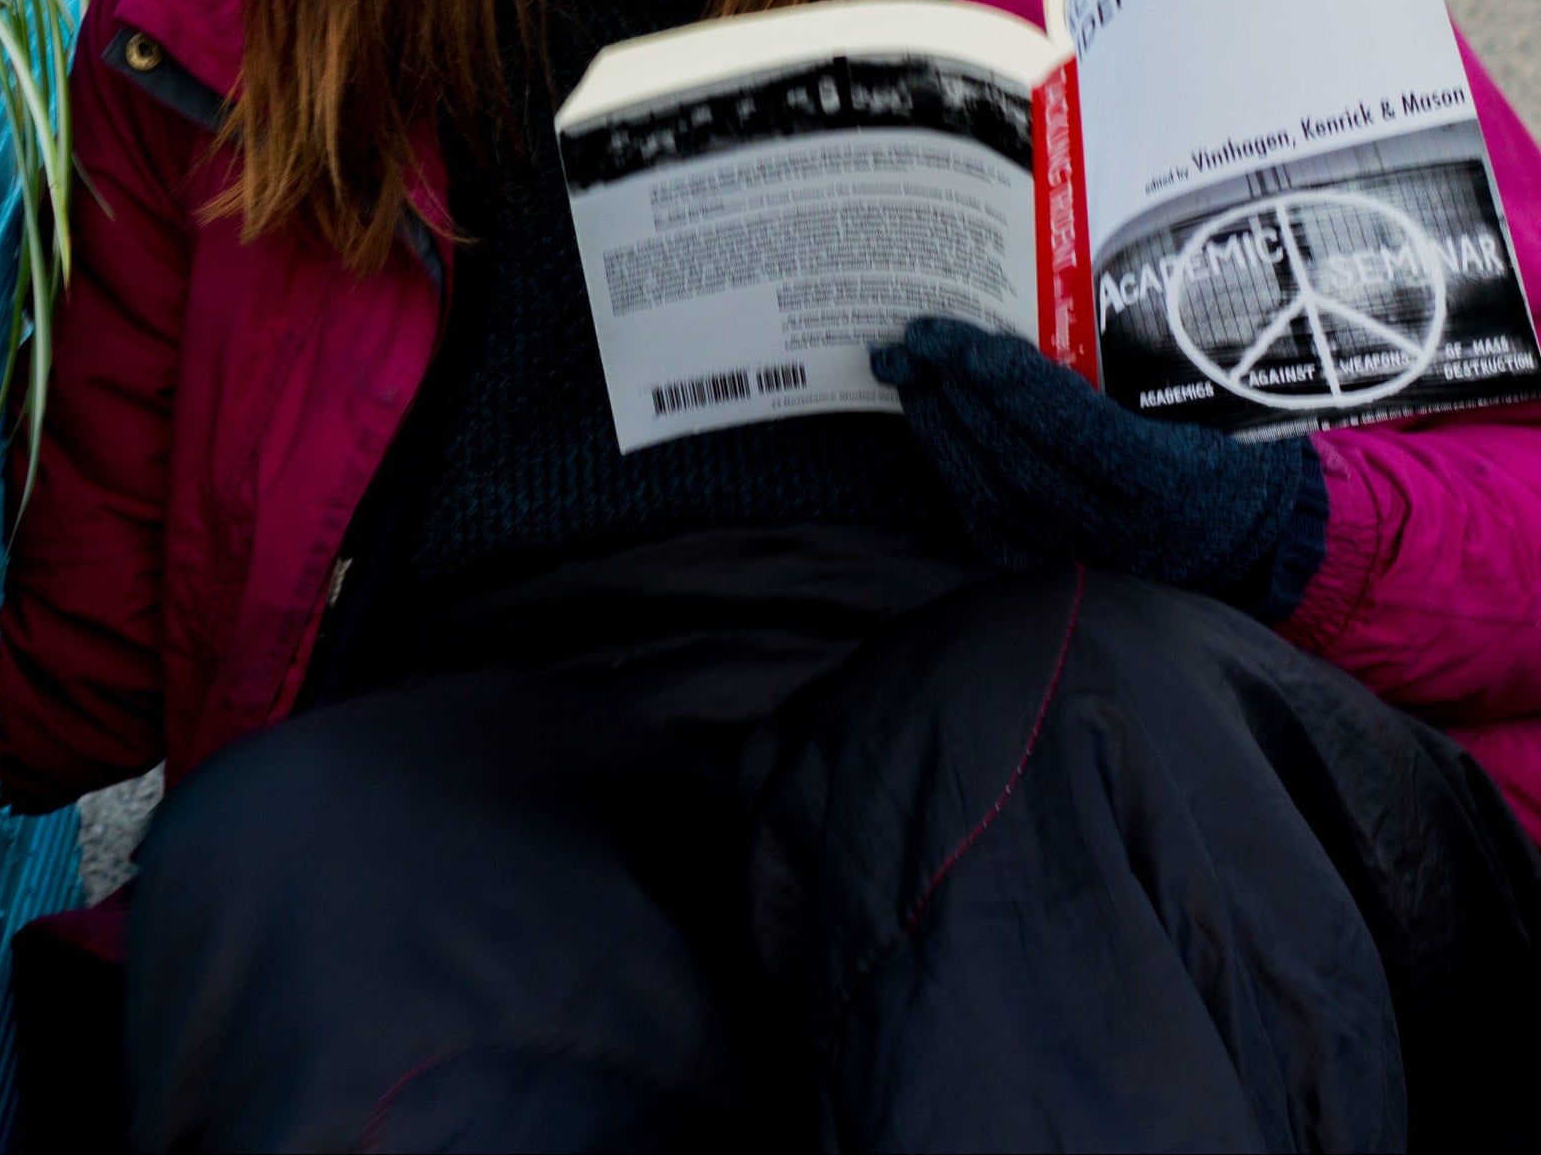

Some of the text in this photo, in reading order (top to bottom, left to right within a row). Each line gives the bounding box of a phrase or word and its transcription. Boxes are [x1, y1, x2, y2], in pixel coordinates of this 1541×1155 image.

[1191, 129, 1297, 173] Vinthagen,
[1300, 100, 1374, 142] Kenrick
[1380, 97, 1396, 120] &
[1401, 85, 1466, 117] Mason
[1099, 228, 1284, 334] ACADEMIC
[1139, 335, 1509, 409] ACADEMICS AGAINST WEAPONS OF MASS
[1443, 352, 1535, 381] DESTRUCTION
